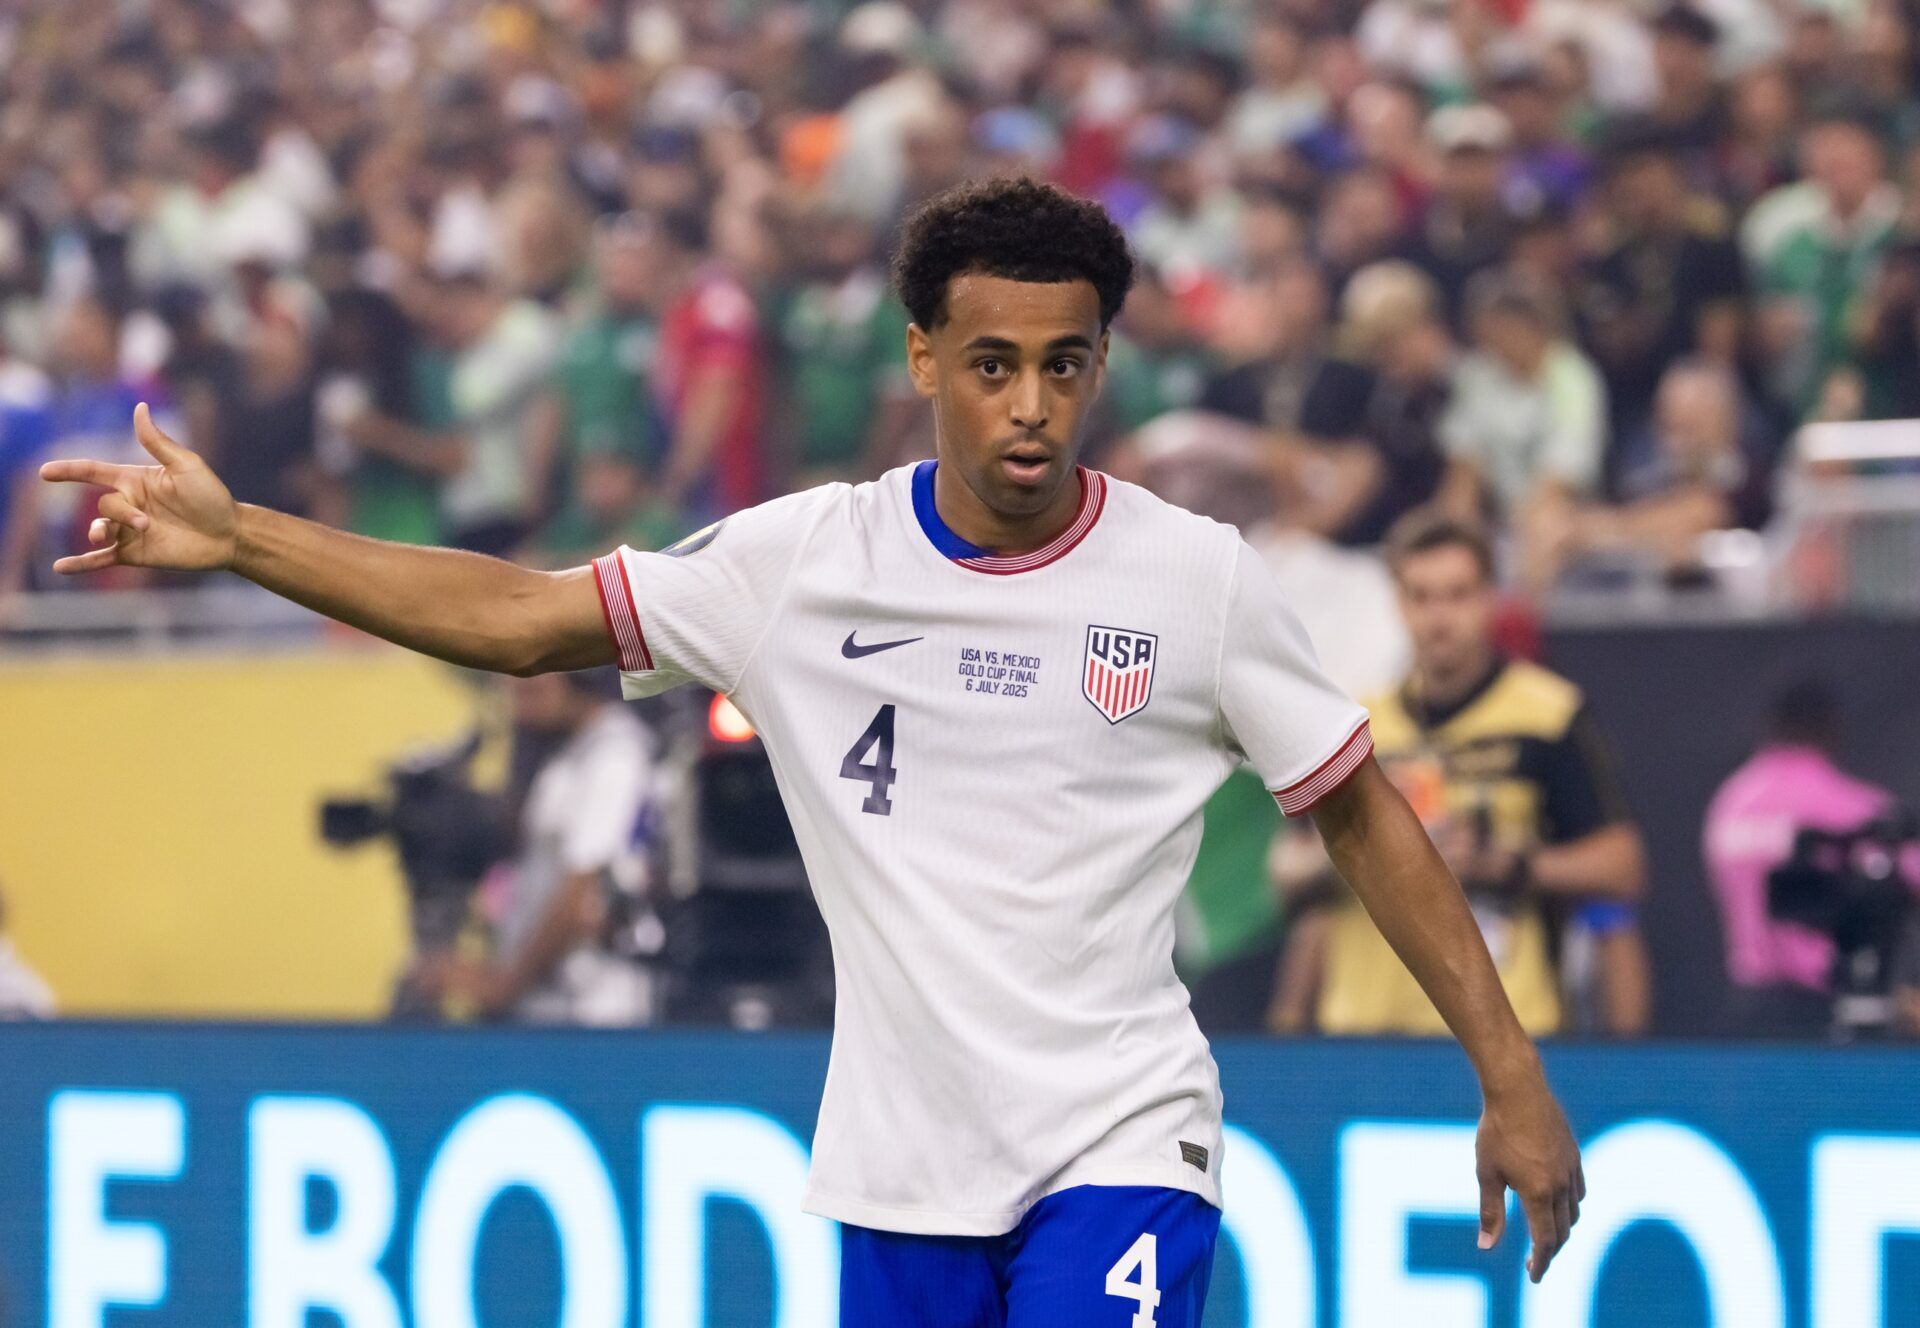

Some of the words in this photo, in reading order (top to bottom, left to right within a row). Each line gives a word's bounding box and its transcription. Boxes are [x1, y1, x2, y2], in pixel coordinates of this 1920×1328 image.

[961, 648, 981, 662] USA
[985, 651, 1000, 665] VS.
[1002, 653, 1041, 670] MEXICO
[1092, 631, 1152, 669] USA
[958, 662, 985, 677] GOLD
[987, 666, 1007, 680] CUP
[1008, 670, 1039, 684] FINAL
[965, 679, 973, 691] 6
[975, 680, 1000, 694] JULY
[1001, 683, 1029, 698] 2025
[838, 703, 898, 817] 4
[1105, 1231, 1162, 1328] 4
